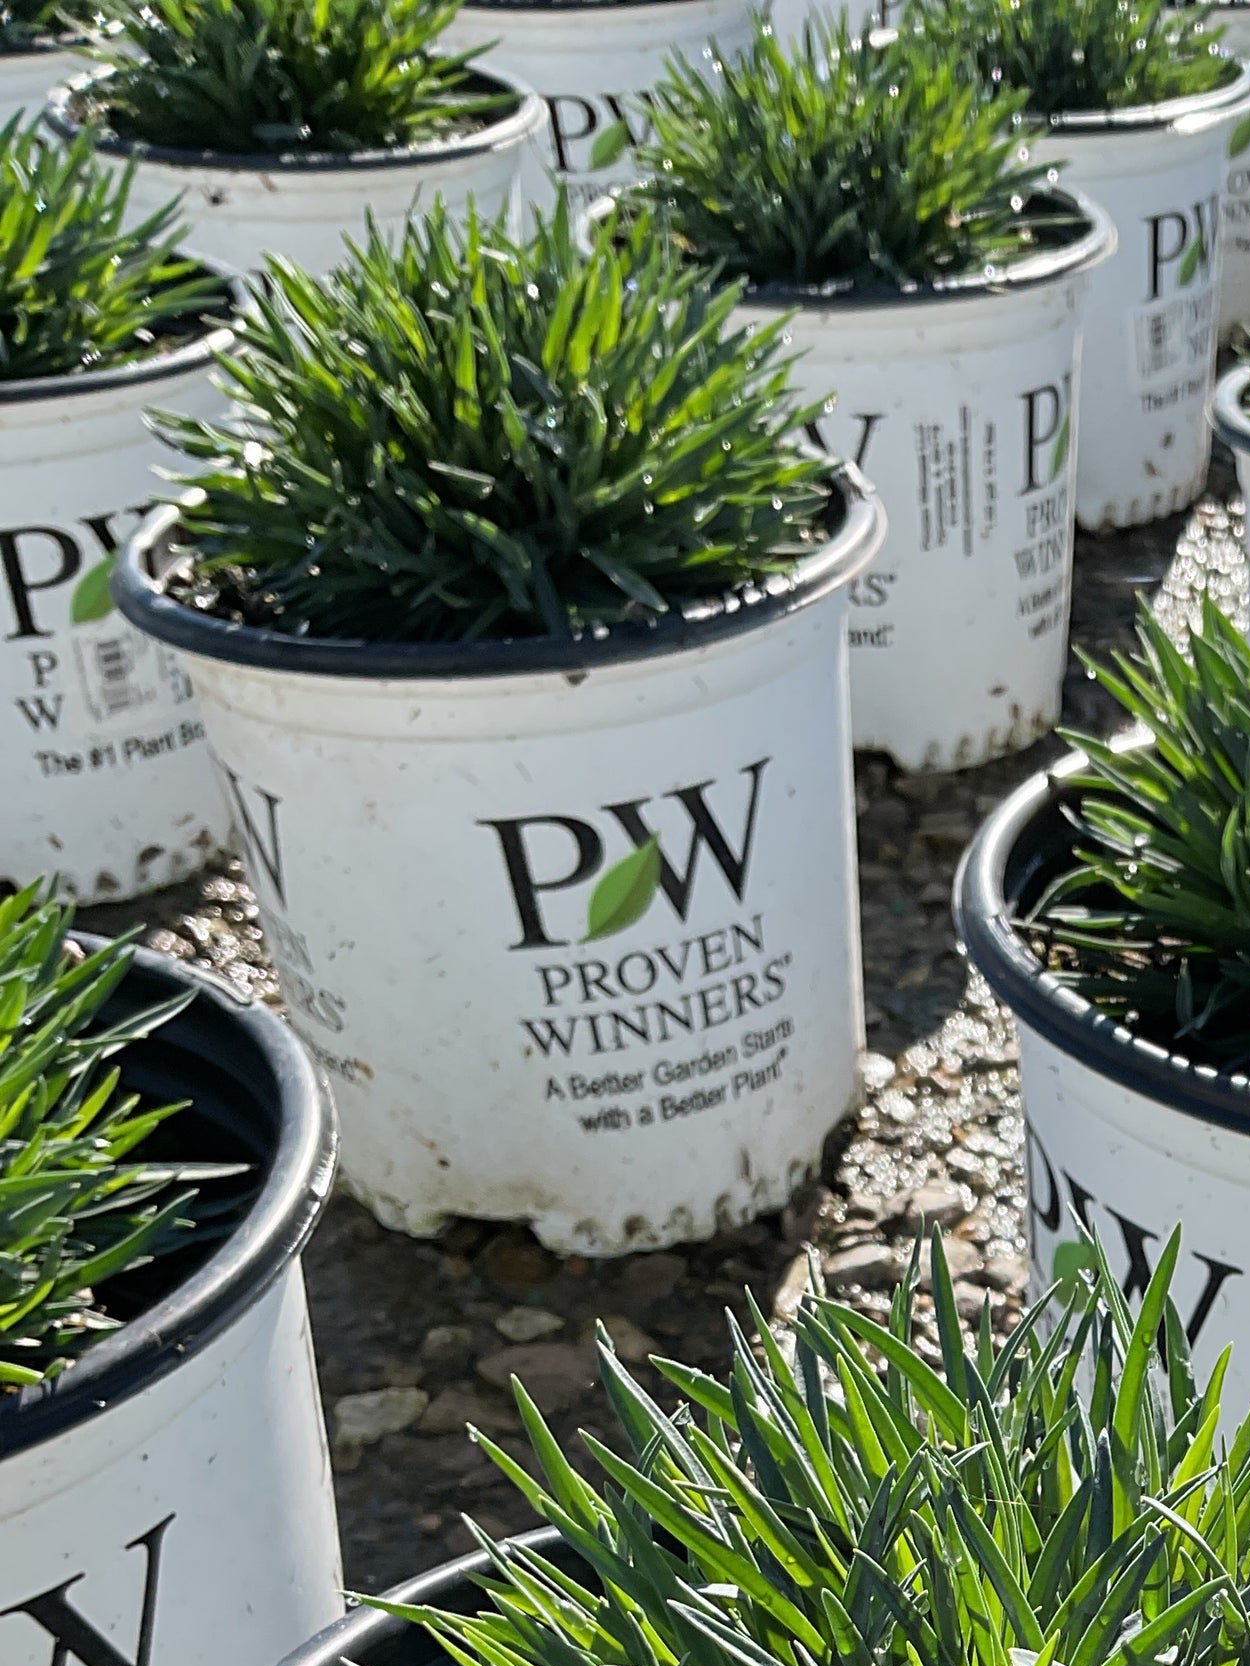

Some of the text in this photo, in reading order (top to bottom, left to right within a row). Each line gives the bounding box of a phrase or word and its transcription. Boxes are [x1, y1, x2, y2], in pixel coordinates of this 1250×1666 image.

[1017, 373, 1071, 497] P
[34, 750, 83, 778] The
[475, 756, 773, 952] PW
[535, 914, 765, 1007] PROVEN
[545, 1076, 566, 1102] A
[567, 1070, 646, 1101] Better
[652, 1044, 739, 1087] Garden
[577, 1103, 632, 1134] with
[637, 1105, 655, 1127] a
[659, 1081, 729, 1123] Better
